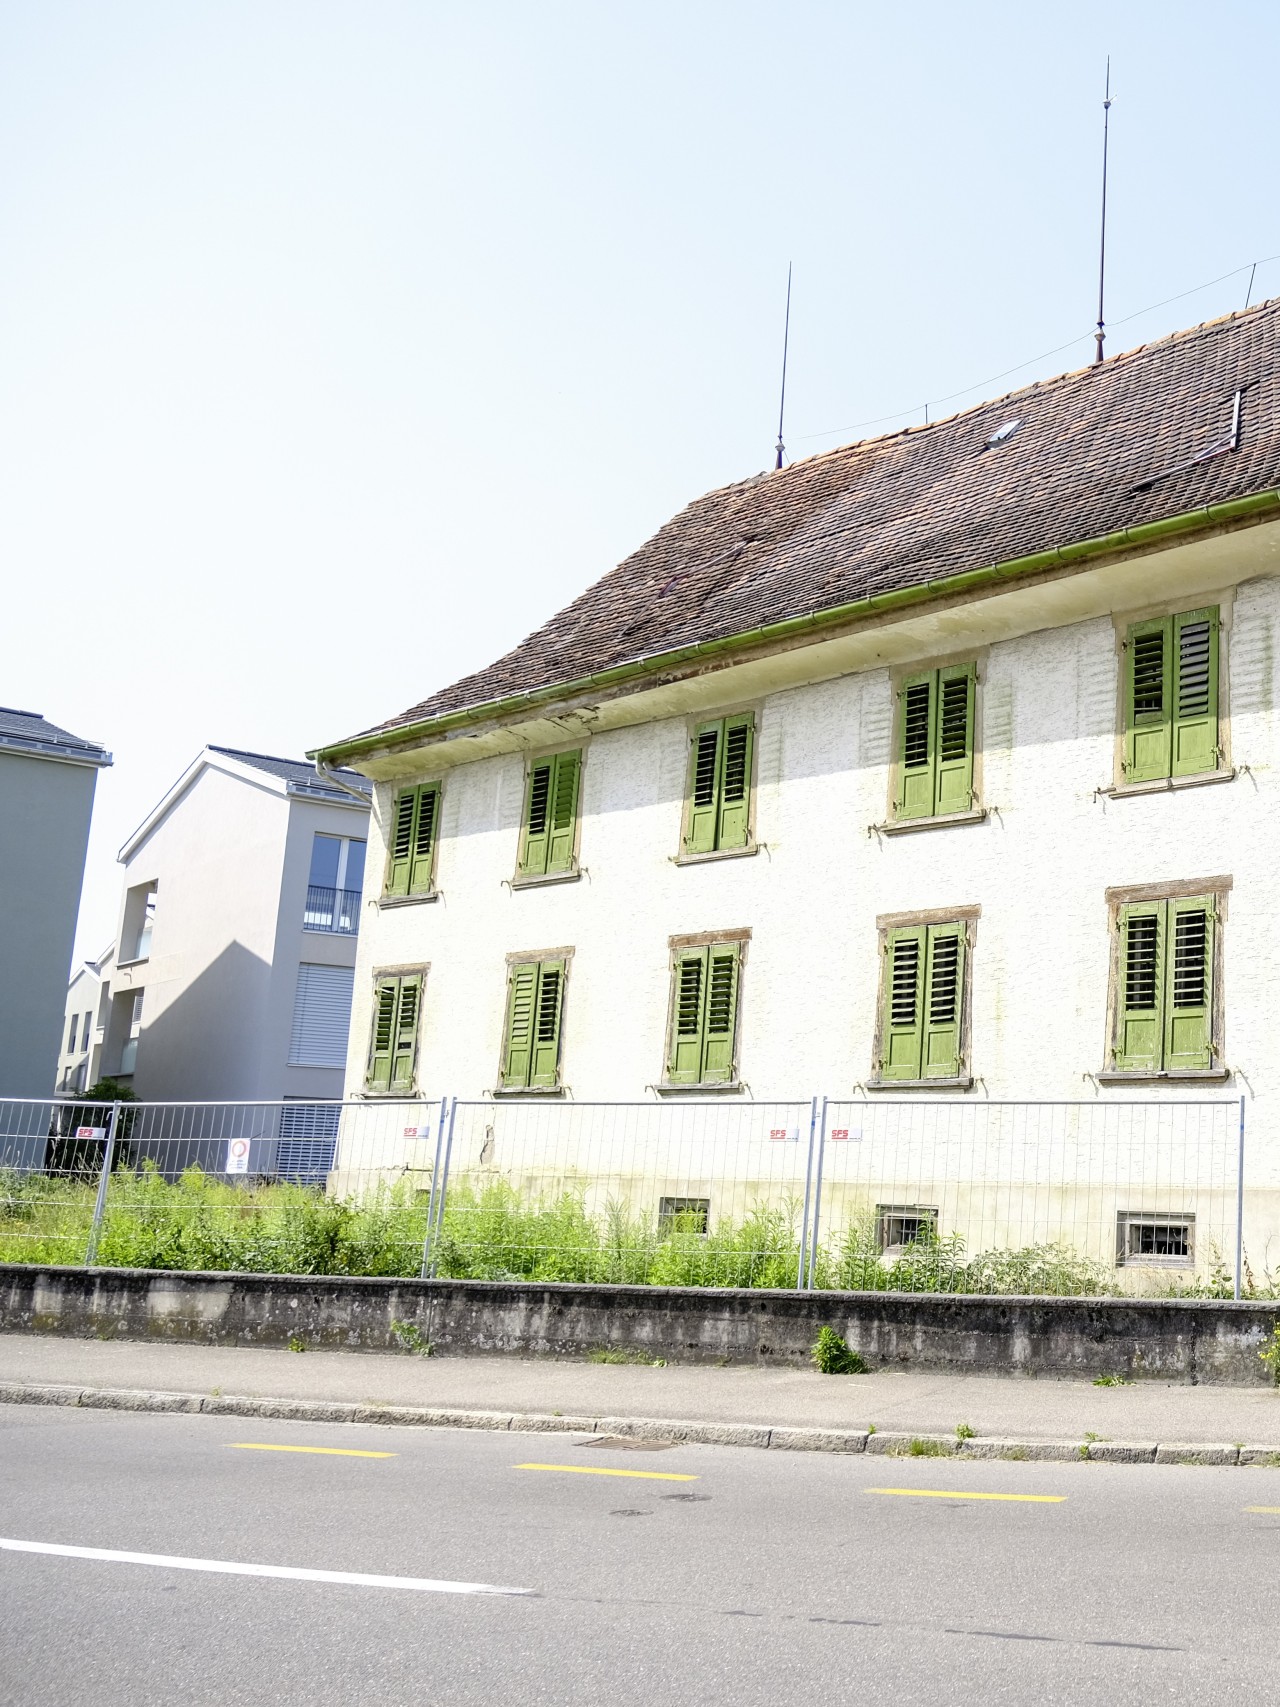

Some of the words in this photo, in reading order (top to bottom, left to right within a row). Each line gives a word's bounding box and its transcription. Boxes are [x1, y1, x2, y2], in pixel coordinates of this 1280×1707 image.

[78, 1128, 93, 1136] SFS
[403, 1127, 417, 1135] SFS
[770, 1129, 786, 1137] SFS
[831, 1129, 849, 1137] SFS
